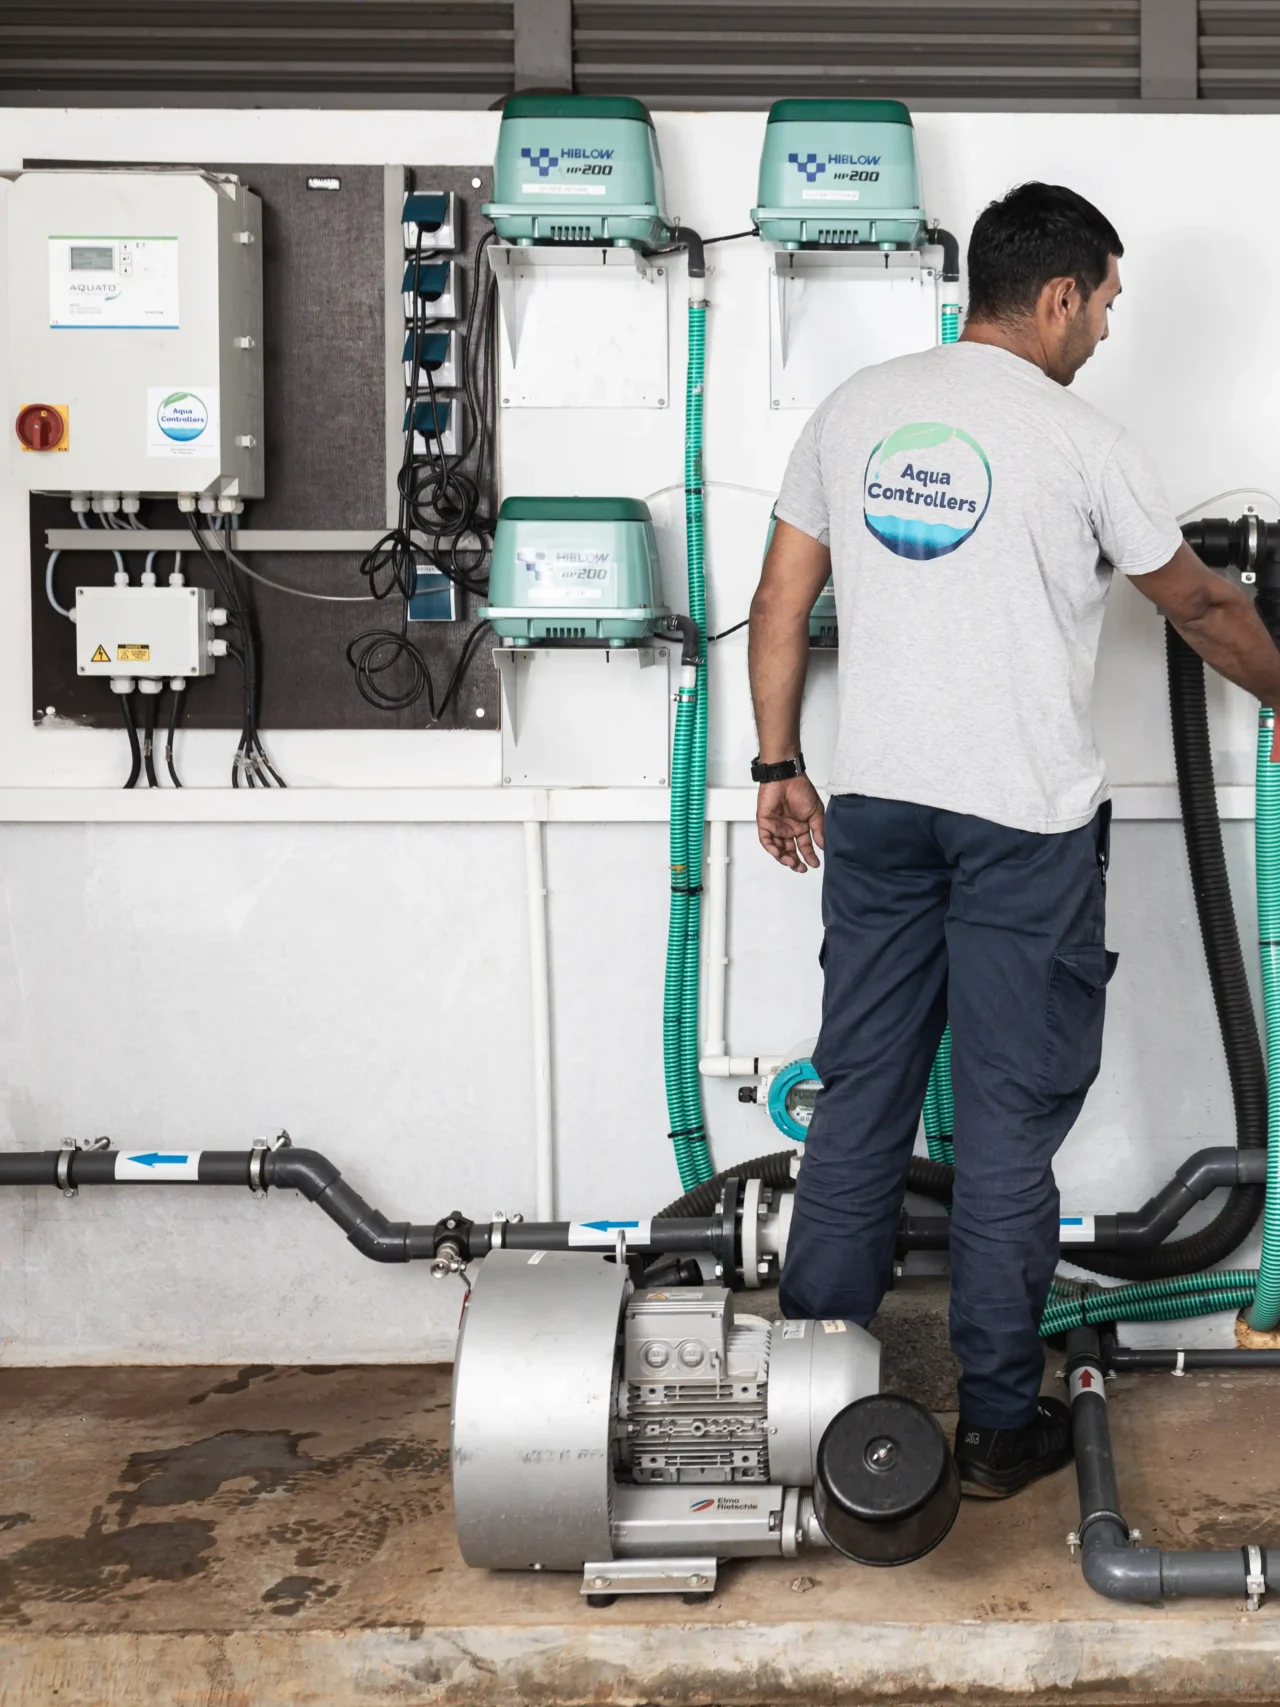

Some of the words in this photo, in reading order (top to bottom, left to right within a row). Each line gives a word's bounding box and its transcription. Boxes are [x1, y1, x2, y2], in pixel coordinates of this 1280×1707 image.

[560, 148, 614, 160] HIBLOW
[827, 153, 881, 166] HIBLOW
[69, 283, 117, 292] AQUATO
[173, 407, 193, 416] Aqua
[161, 415, 205, 423] Controllers
[900, 463, 951, 487] Aqua
[867, 482, 977, 514] Controllers
[556, 552, 610, 564] HIBLOW
